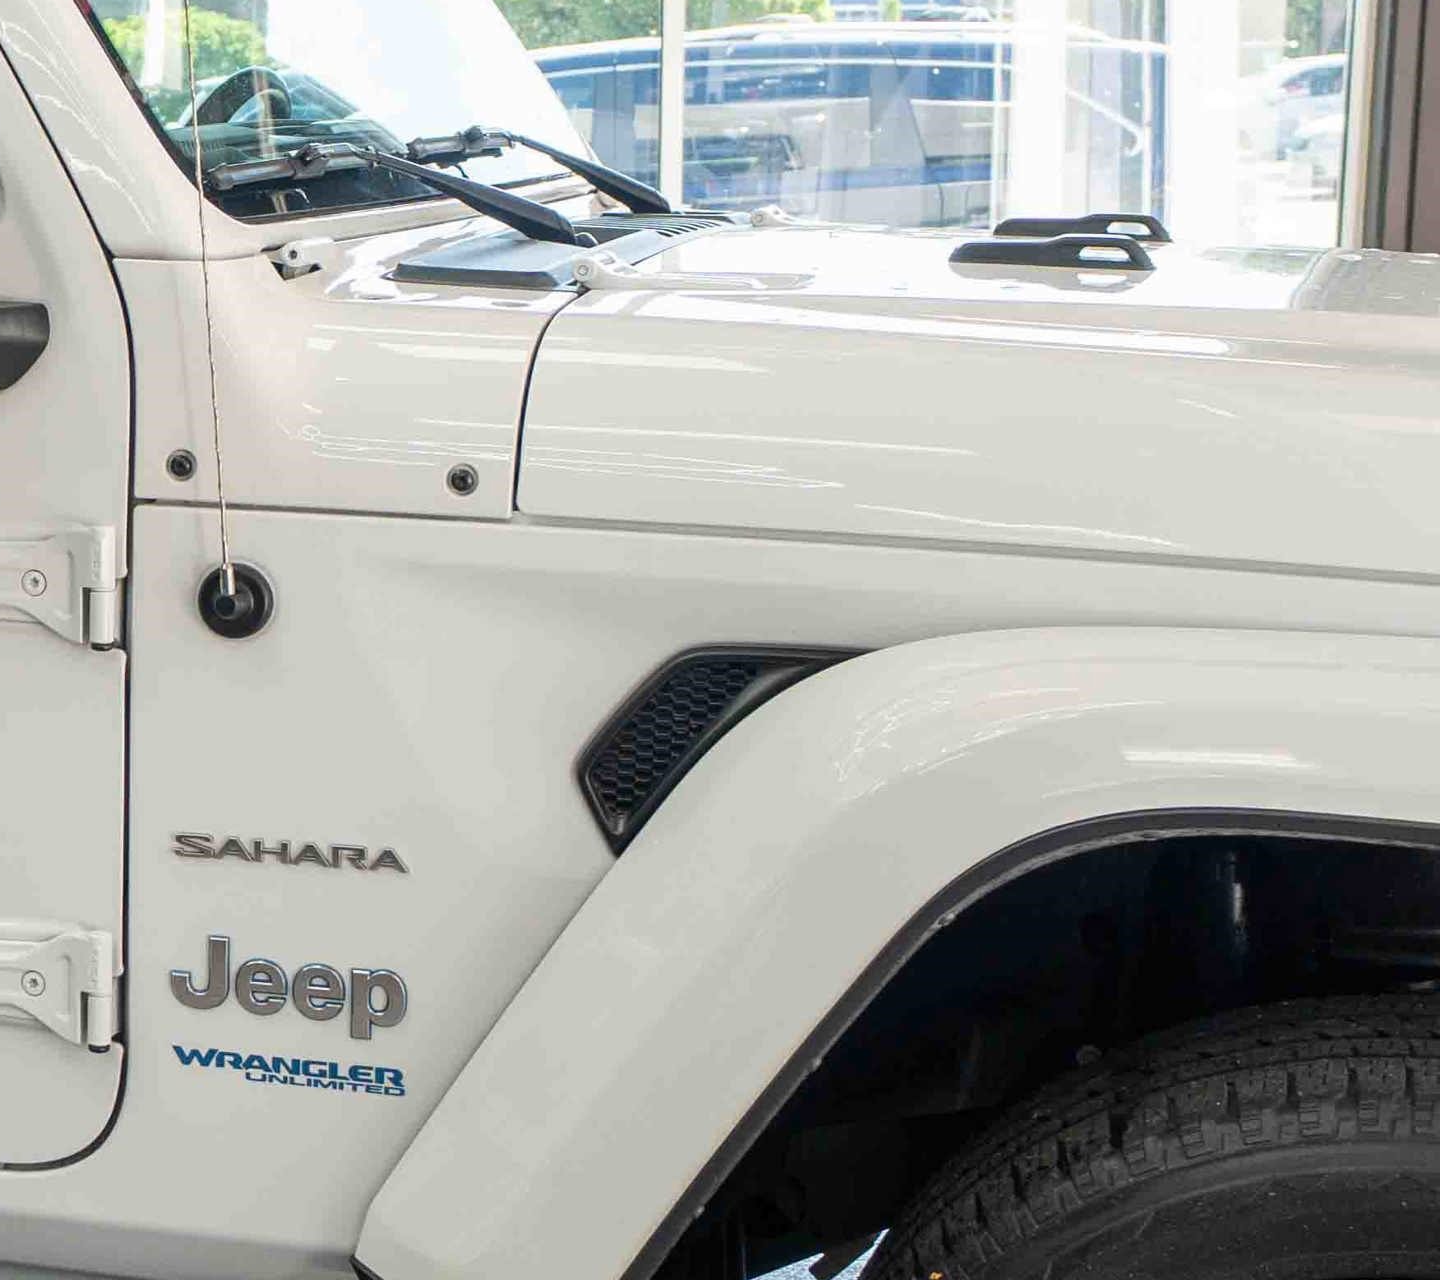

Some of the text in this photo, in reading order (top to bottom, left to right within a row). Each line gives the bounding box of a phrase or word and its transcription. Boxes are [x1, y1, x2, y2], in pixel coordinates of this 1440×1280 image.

[172, 832, 411, 873] SAHARA
[169, 934, 409, 1041] Jeep
[172, 1044, 406, 1089] WRANGLER
[245, 1070, 407, 1098] UNLIMITED
